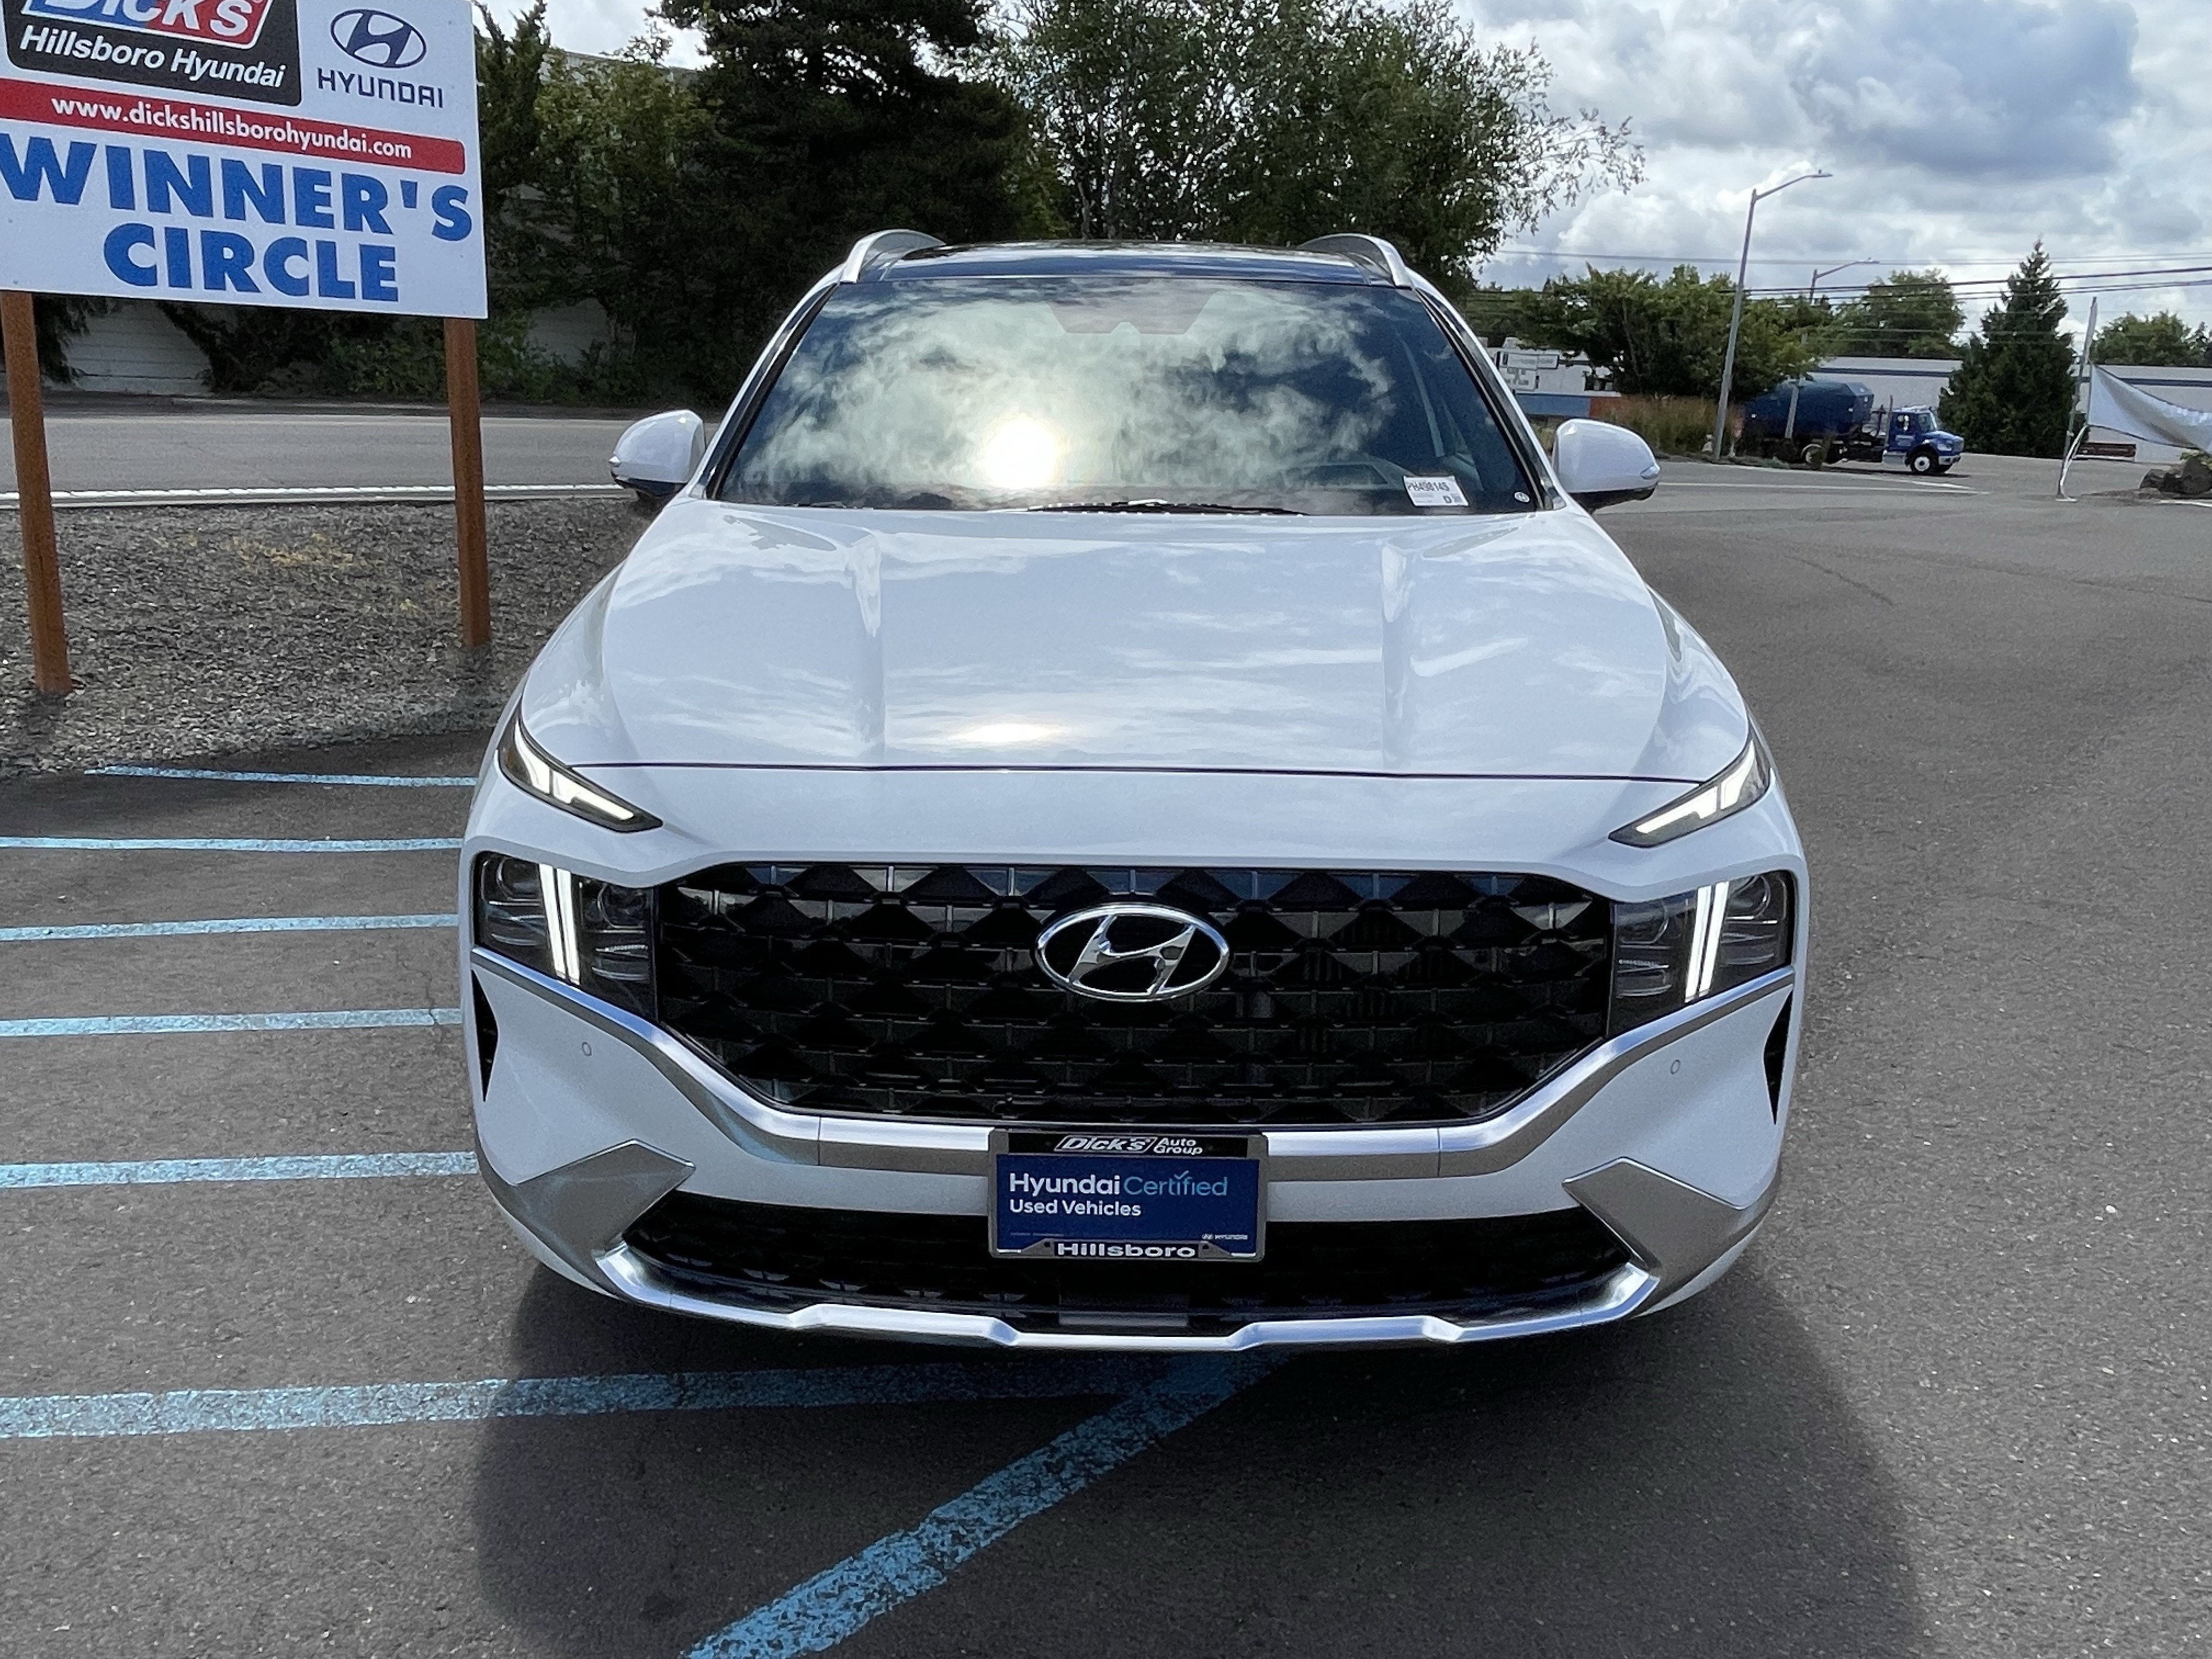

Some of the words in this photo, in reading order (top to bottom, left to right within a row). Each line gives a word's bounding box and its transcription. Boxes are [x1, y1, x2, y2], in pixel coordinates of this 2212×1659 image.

[20, 25, 166, 69] Hillsboro
[170, 48, 286, 88] Hyundai
[317, 68, 443, 109] HYUNDAI
[52, 98, 412, 160] www.dickshillsborohyundai.com
[0, 133, 472, 242] WINNER'S
[103, 223, 399, 303] CIRCLE
[1153, 1146, 1203, 1155] Group
[1156, 1137, 1197, 1147] Auto
[1009, 1172, 1120, 1197] Hyundai
[1124, 1170, 1228, 1196] Certified
[1009, 1199, 1058, 1214] Used
[1062, 1200, 1142, 1216] Vehicles
[1058, 1243, 1195, 1257] Hillsboro
